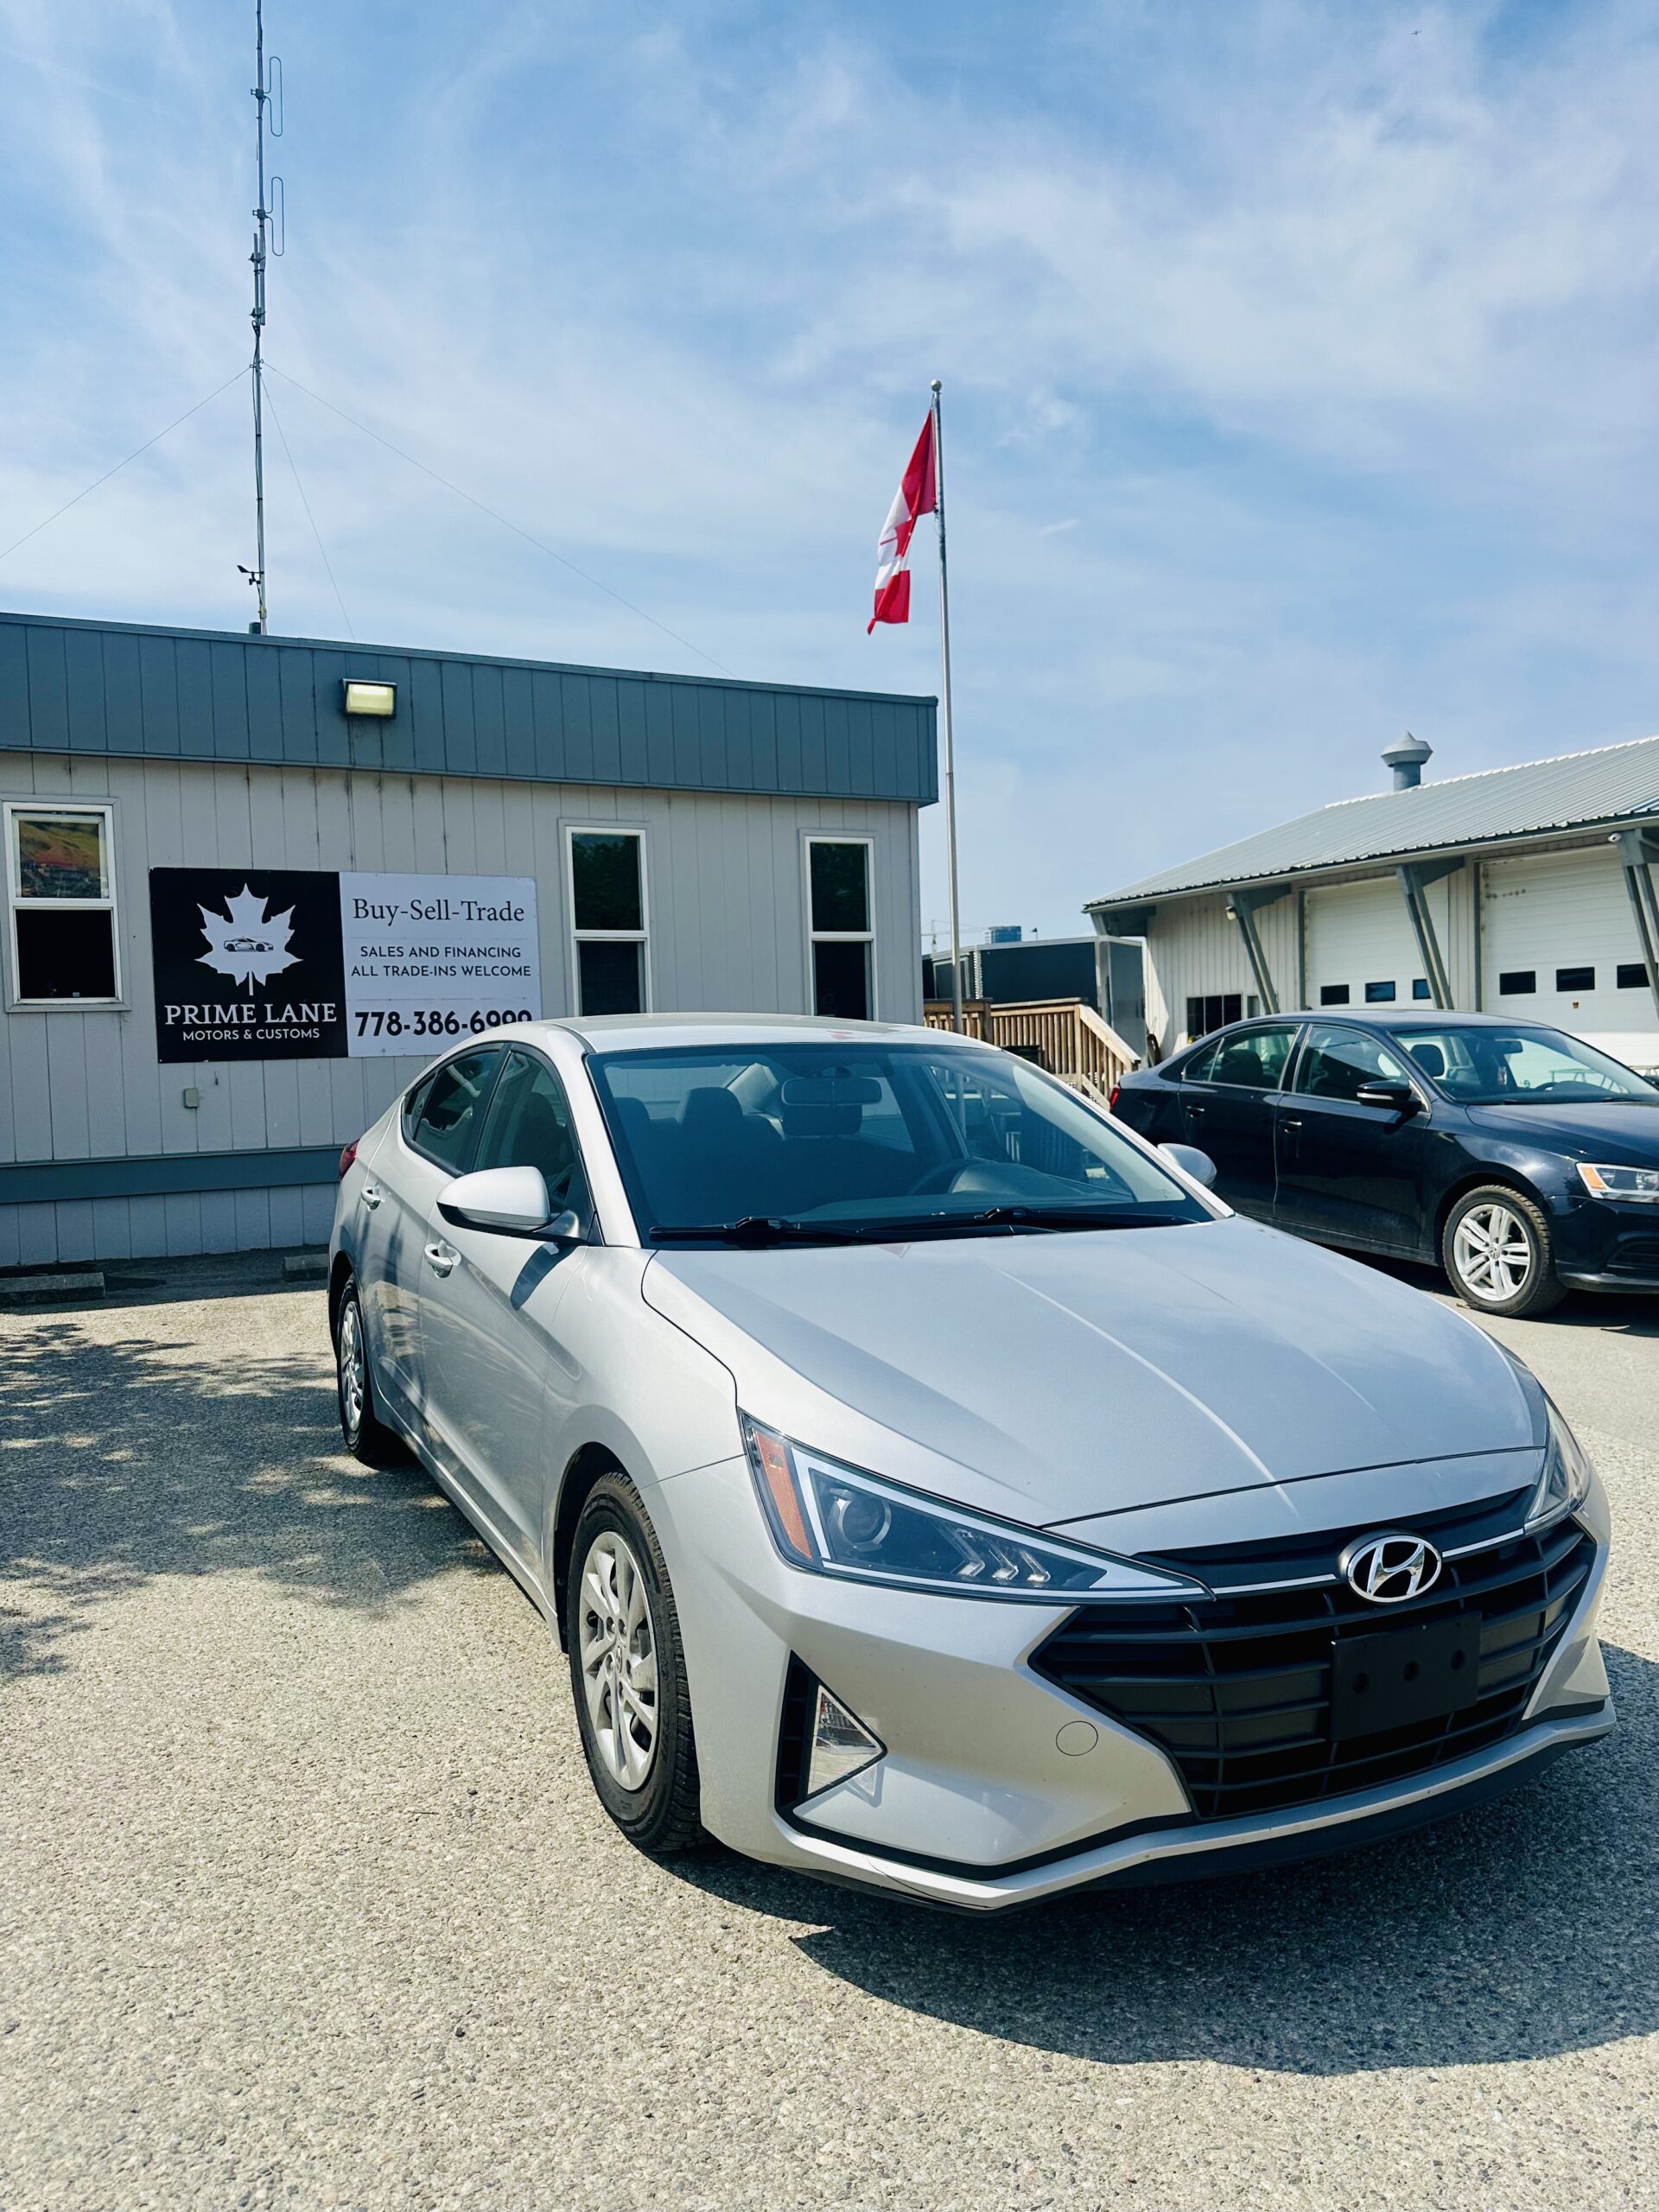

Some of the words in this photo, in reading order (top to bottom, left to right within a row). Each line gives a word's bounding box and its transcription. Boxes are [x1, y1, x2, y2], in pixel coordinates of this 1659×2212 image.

[352, 898, 525, 927] Buy-Sell-Trade
[360, 945, 404, 958] SALES
[408, 946, 441, 958] AND
[444, 946, 522, 958] FINANCING
[351, 965, 378, 977] ALL
[383, 965, 457, 977] TRADE-INS
[461, 965, 532, 977] WELCOME
[164, 1004, 257, 1026] PRIME
[264, 1002, 338, 1024] LANE
[182, 1030, 239, 1041] MOTORS
[243, 1029, 253, 1040] &
[256, 1027, 321, 1040] CUSTOMS
